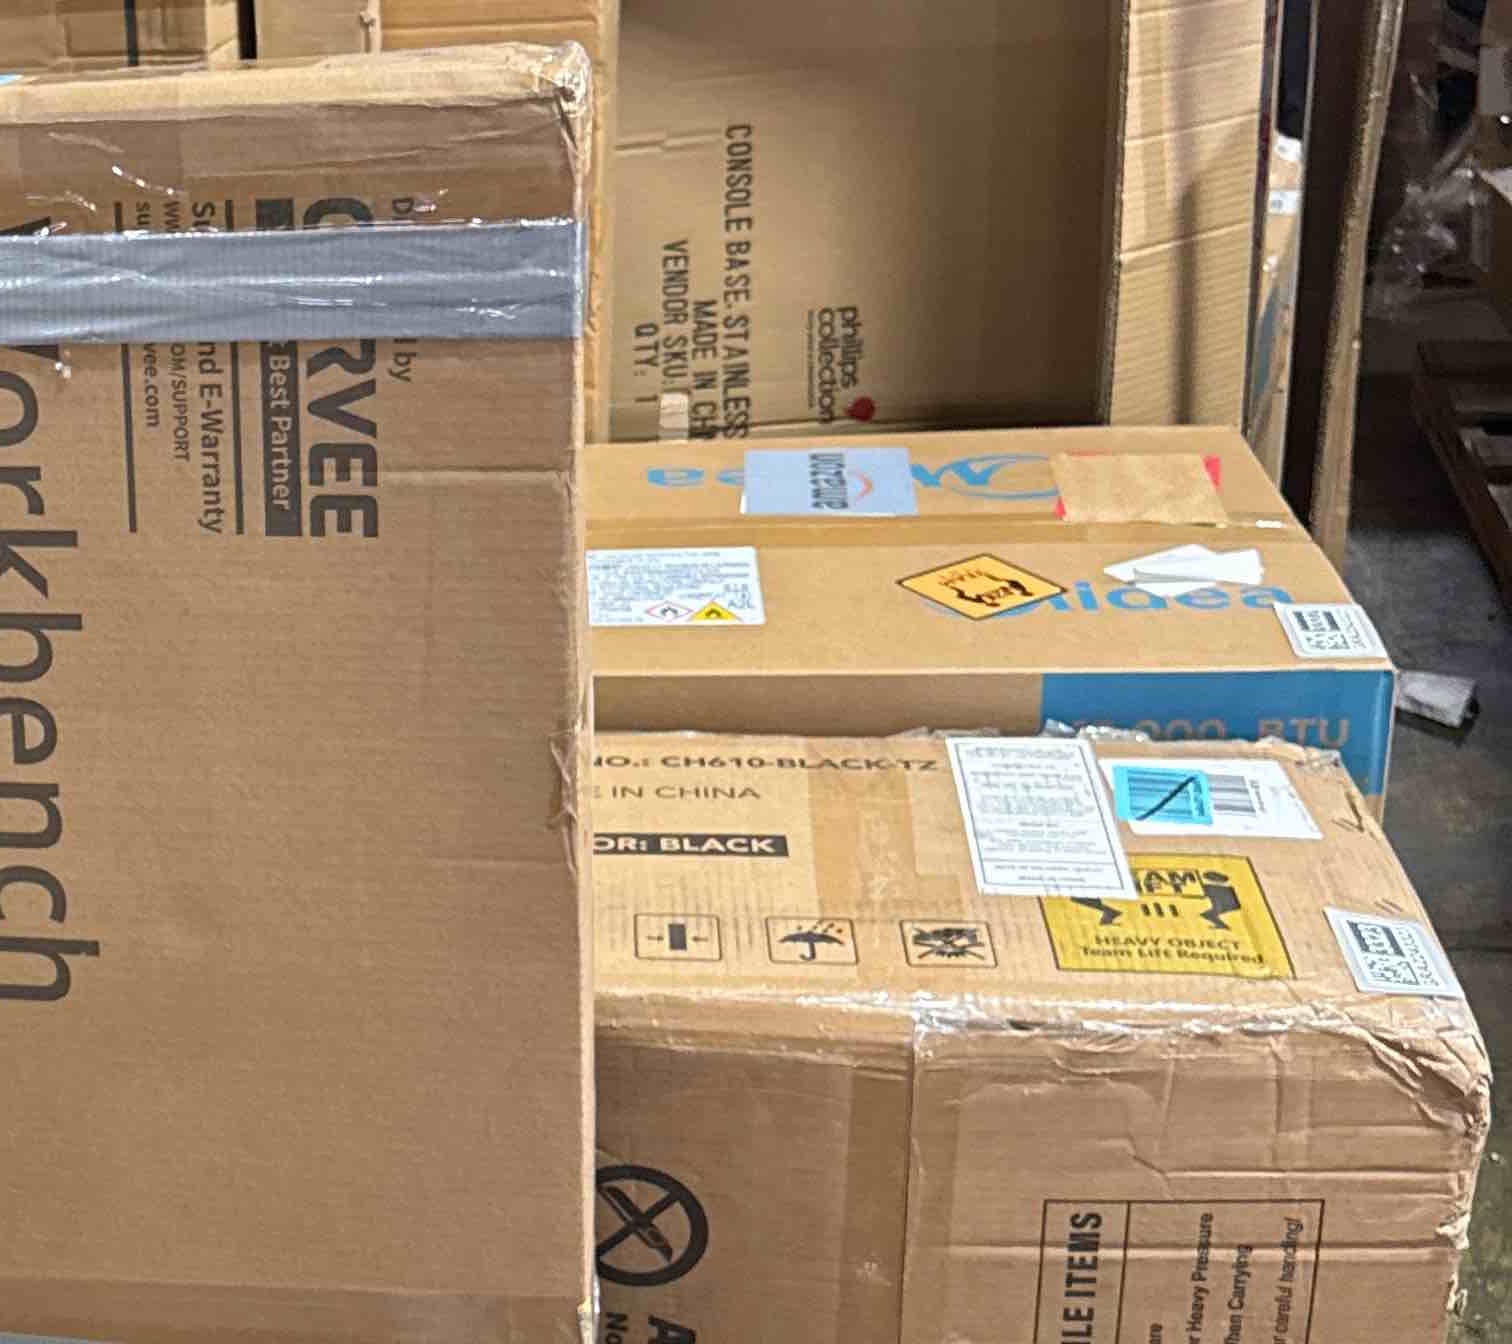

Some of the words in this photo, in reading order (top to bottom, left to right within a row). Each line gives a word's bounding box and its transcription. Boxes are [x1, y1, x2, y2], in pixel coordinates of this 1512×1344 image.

[723, 123, 753, 234] CONSOLE
[662, 239, 689, 326] VENDOR
[633, 322, 659, 377] QTY:
[691, 299, 717, 360] MADE
[268, 356, 293, 411] Best
[389, 352, 414, 384] by
[691, 370, 717, 395] IN
[722, 312, 751, 440] STAINLESS
[817, 307, 840, 424] collection
[196, 380, 224, 535] E-Warranty
[268, 416, 293, 510] Partner
[610, 784, 645, 800] IN
[653, 784, 762, 801] CHINA
[658, 835, 777, 855] BLACK
[1080, 946, 1133, 960] Team
[1136, 947, 1173, 961] Lift
[1175, 948, 1266, 966] Required
[1093, 934, 1161, 948] HEAVY
[1167, 936, 1242, 952] OBJECT
[1065, 1210, 1104, 1301] ITEMS
[1190, 1212, 1214, 1282] Pressure
[1226, 1243, 1253, 1311] Carrying
[1184, 1286, 1210, 1334] Heavy
[1271, 1286, 1294, 1334] careful
